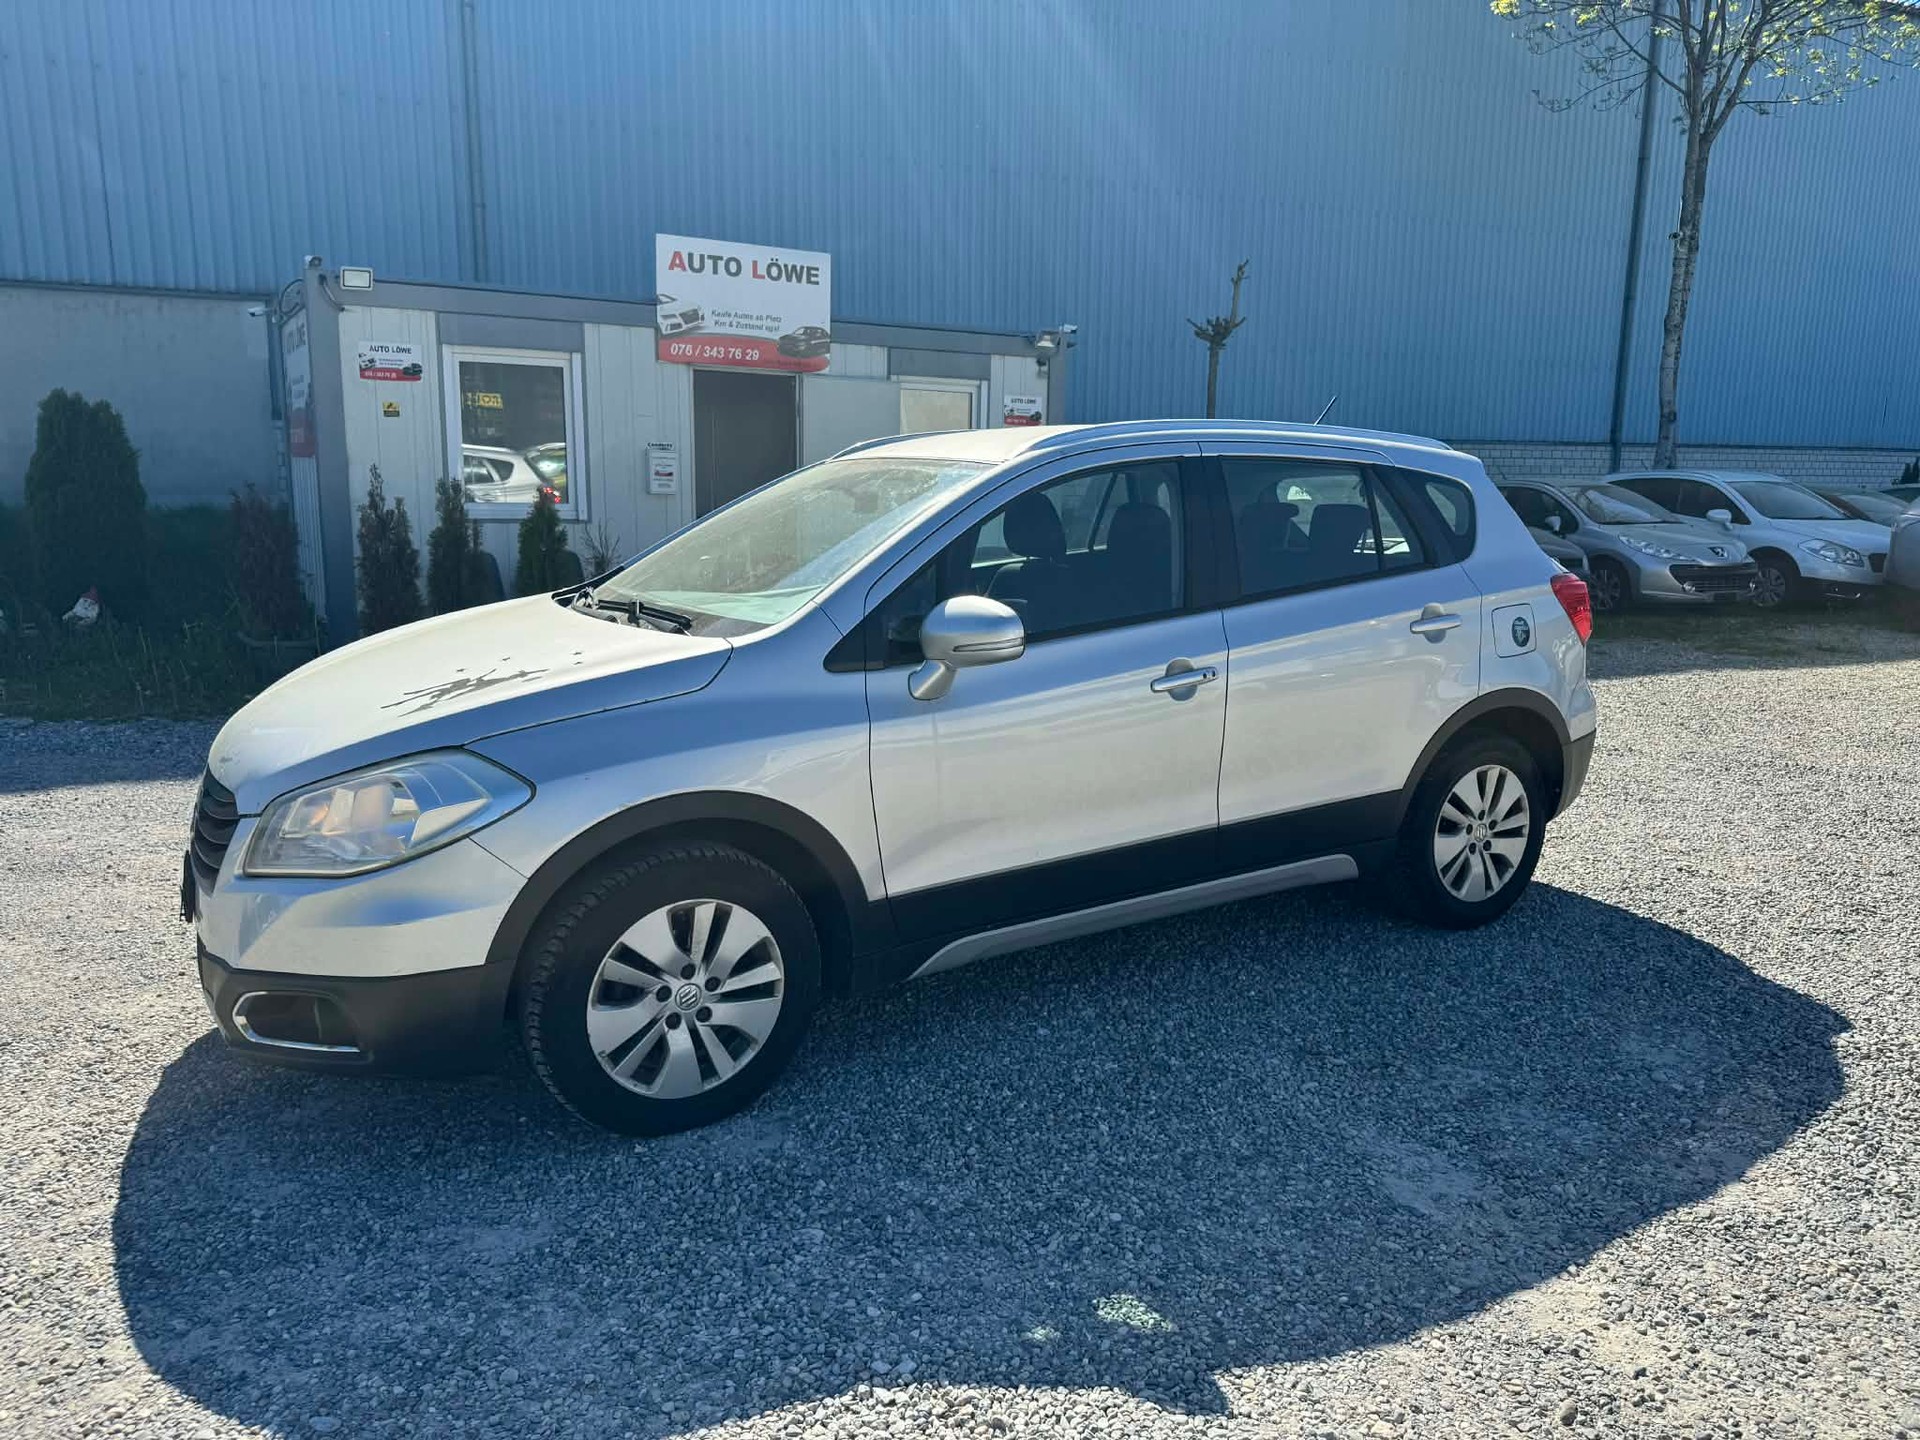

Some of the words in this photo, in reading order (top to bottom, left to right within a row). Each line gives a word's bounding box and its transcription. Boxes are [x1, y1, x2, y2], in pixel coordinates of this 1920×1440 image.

[668, 251, 742, 276] AUTO
[752, 257, 820, 285] LÖWE
[369, 345, 390, 353] AUTO
[703, 346, 725, 358] 343
[728, 348, 742, 360] 76
[745, 349, 760, 361] 29
